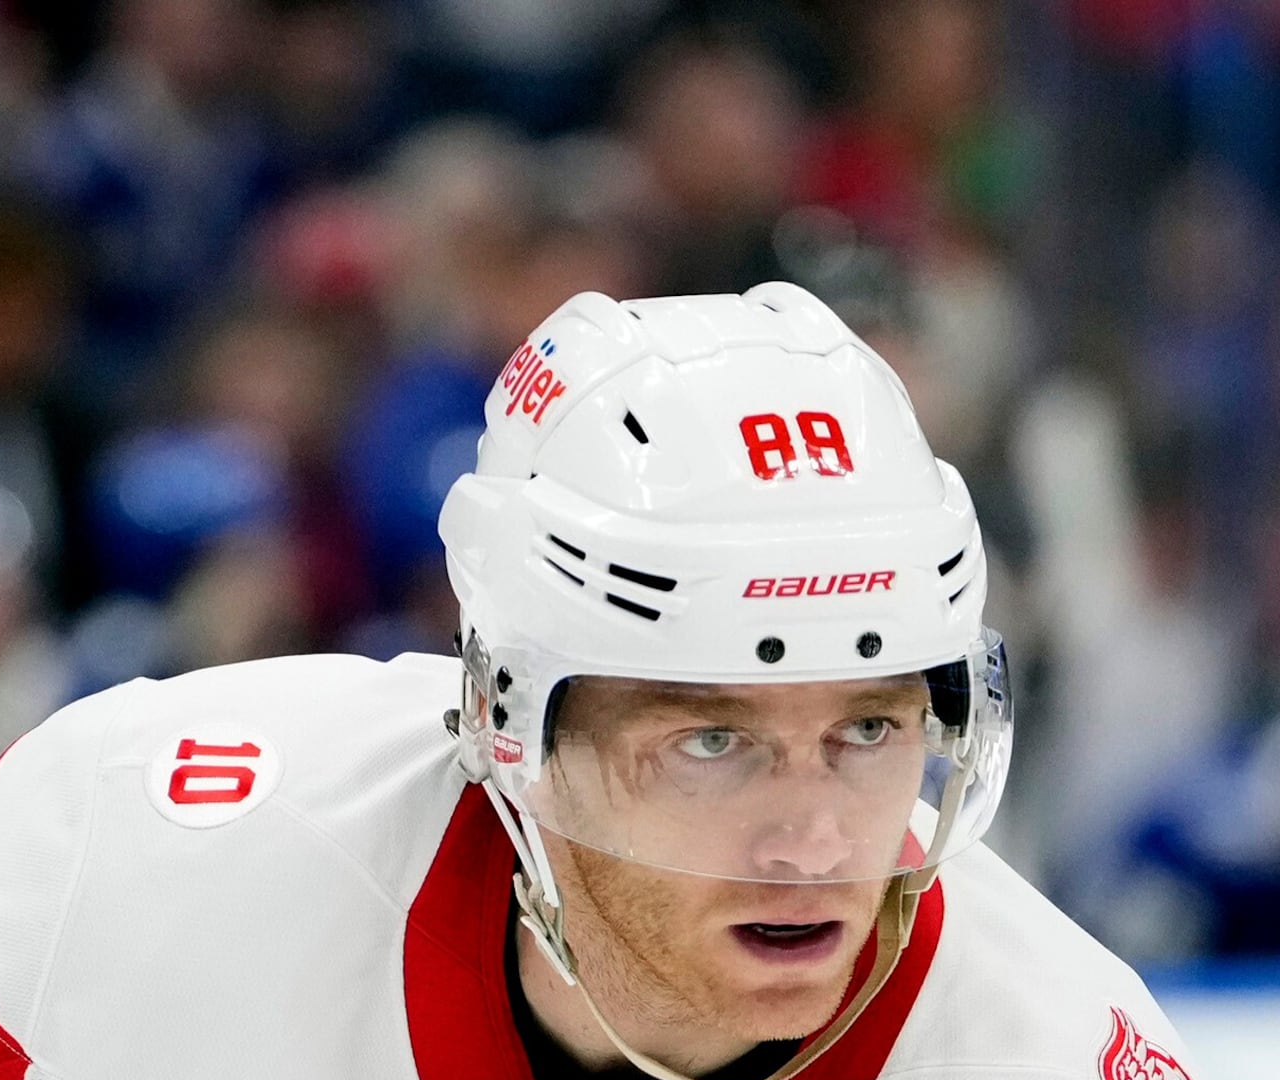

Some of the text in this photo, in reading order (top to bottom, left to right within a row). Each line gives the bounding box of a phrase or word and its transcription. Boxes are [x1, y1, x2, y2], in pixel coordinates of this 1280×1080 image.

[739, 411, 855, 481] 88
[742, 570, 896, 598] BAUER
[167, 738, 263, 805] 10
